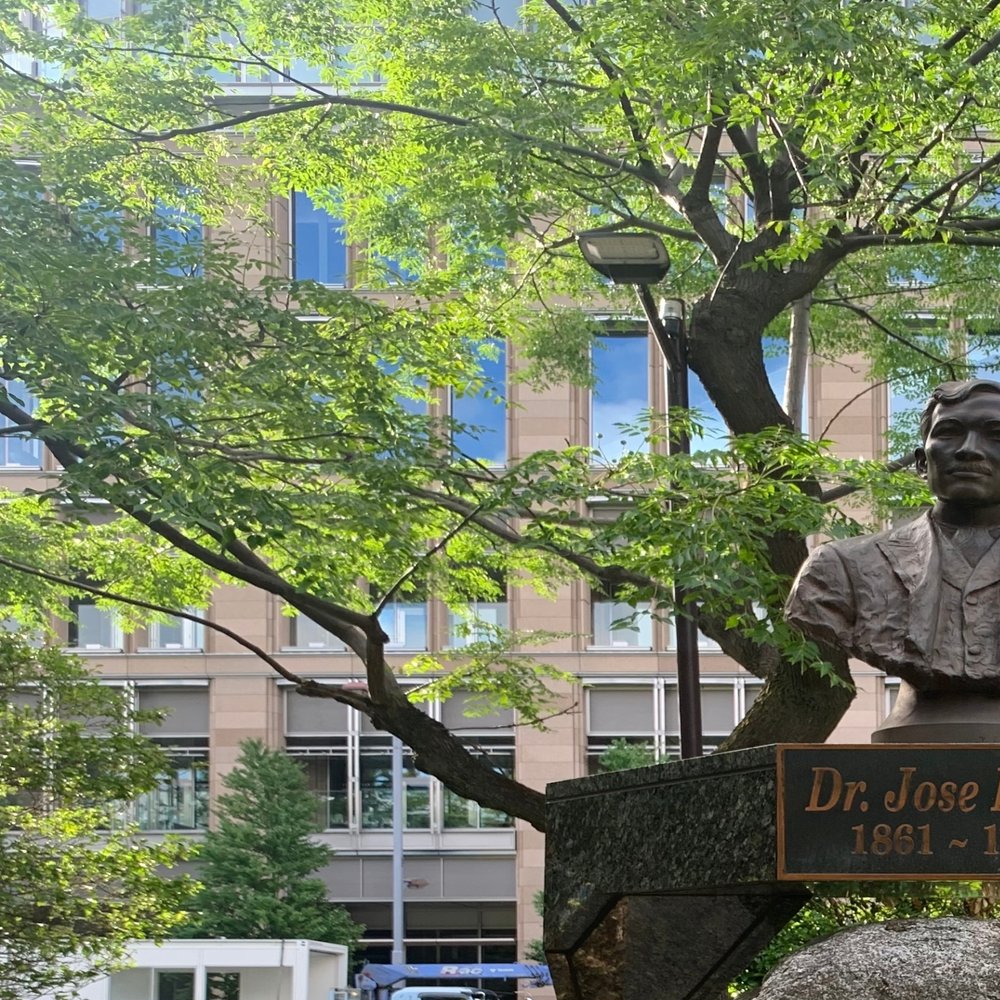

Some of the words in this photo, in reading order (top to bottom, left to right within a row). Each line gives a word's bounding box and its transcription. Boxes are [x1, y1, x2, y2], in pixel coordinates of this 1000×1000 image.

[805, 766, 869, 813] Dr.
[884, 766, 979, 813] Jose
[850, 824, 934, 856] 1861
